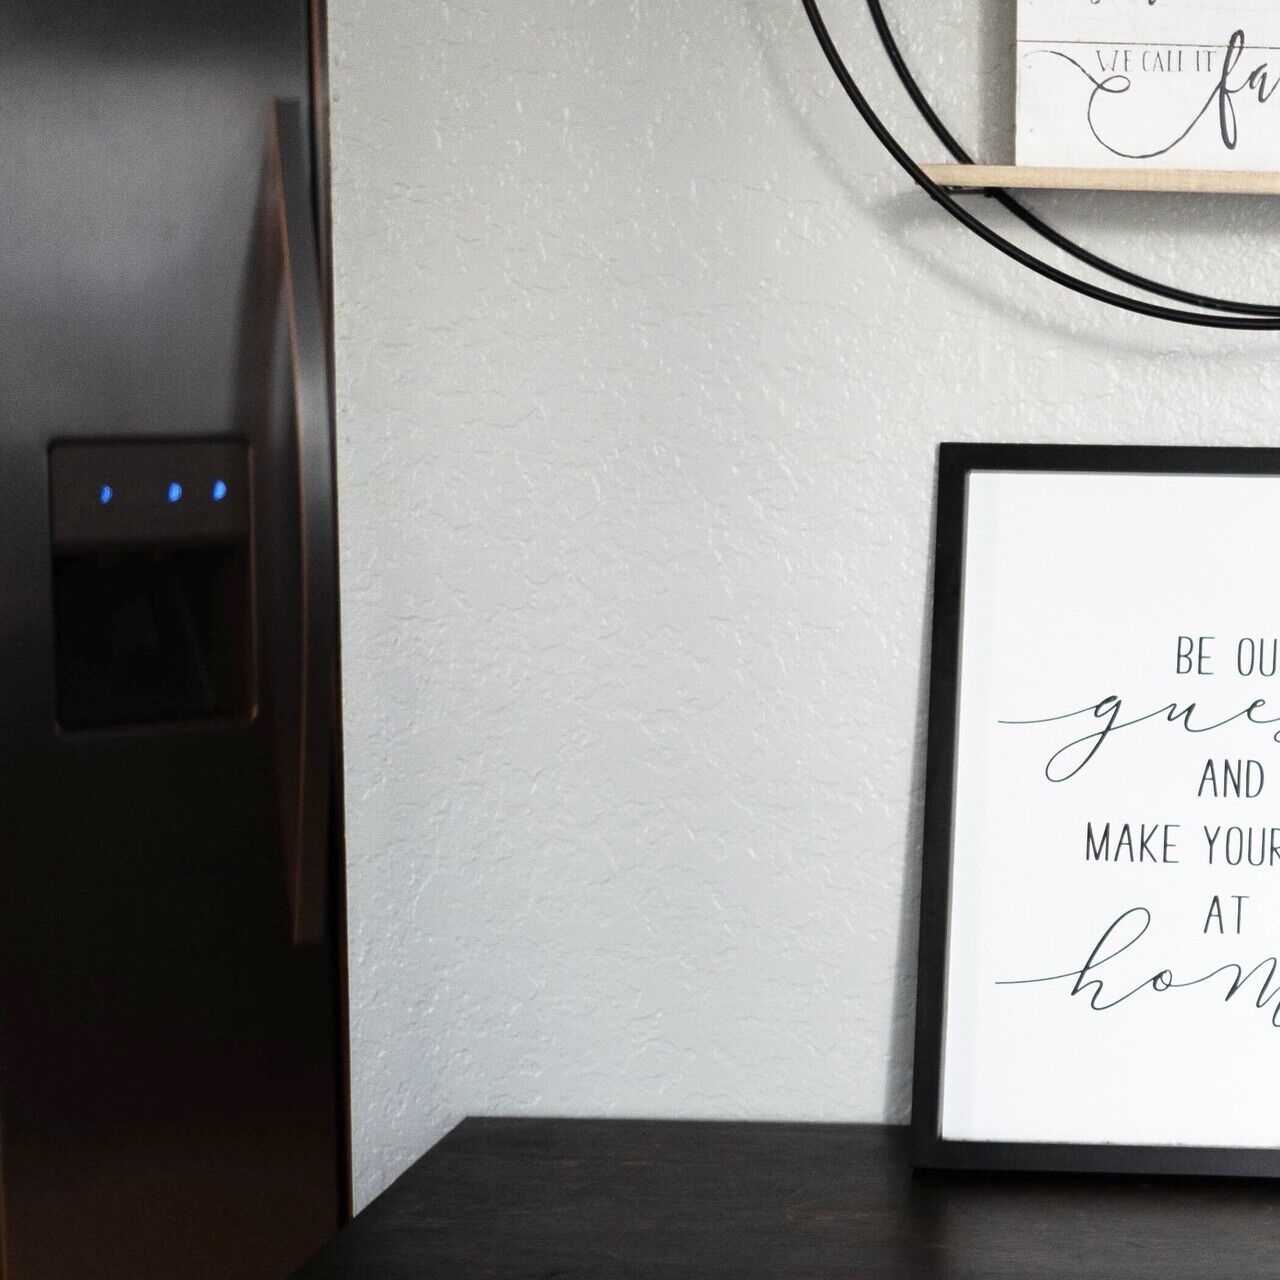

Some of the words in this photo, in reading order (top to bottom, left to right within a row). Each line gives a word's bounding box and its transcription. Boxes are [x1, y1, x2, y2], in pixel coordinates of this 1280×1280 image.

[1095, 49, 1133, 73] WE
[1195, 50, 1218, 73] IT
[1175, 635, 1216, 676] BE
[1197, 758, 1266, 799] AND
[1084, 821, 1181, 865] MAKE
[1203, 895, 1250, 935] AT
